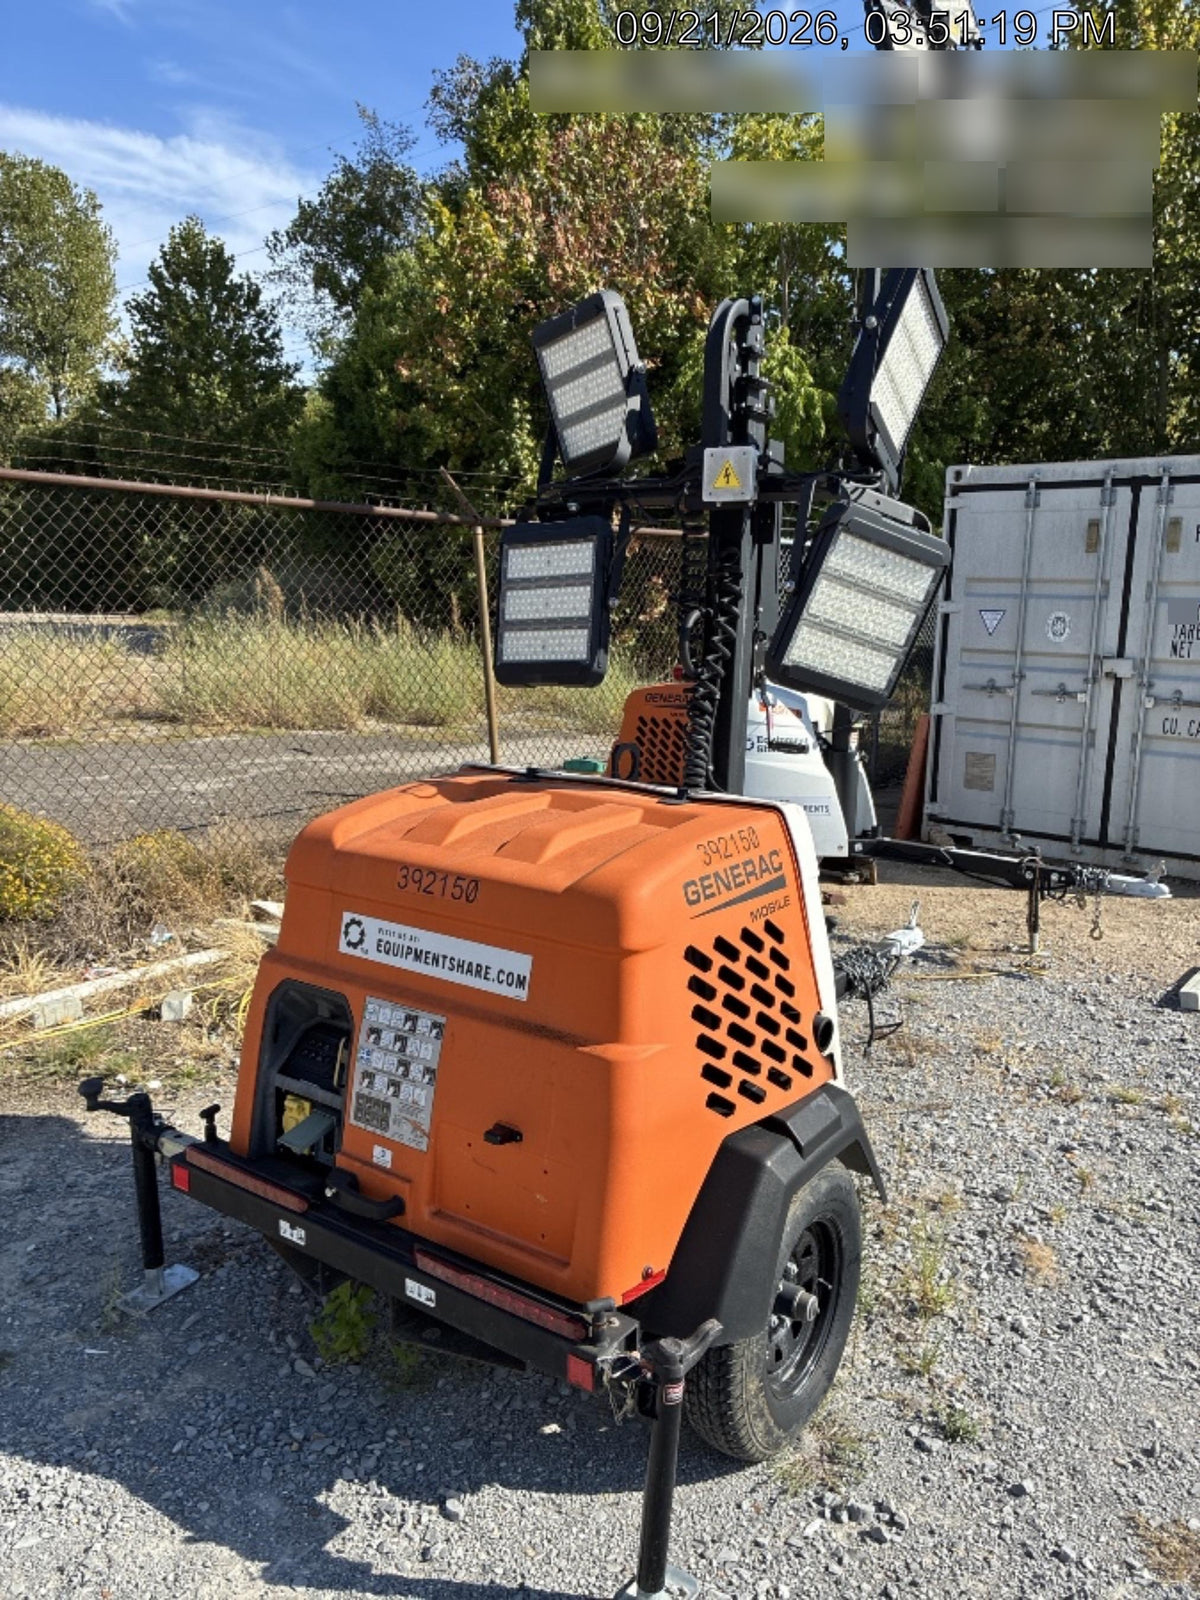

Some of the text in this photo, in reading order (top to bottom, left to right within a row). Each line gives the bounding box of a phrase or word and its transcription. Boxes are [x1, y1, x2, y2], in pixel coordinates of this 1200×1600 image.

[1170, 641, 1193, 659] NET
[697, 826, 760, 866] 392150
[397, 865, 480, 903] 392150
[682, 849, 783, 907] GENERAC
[750, 896, 791, 923] MOBILE
[376, 938, 527, 991] EQUIPMENTSHARE.COM
